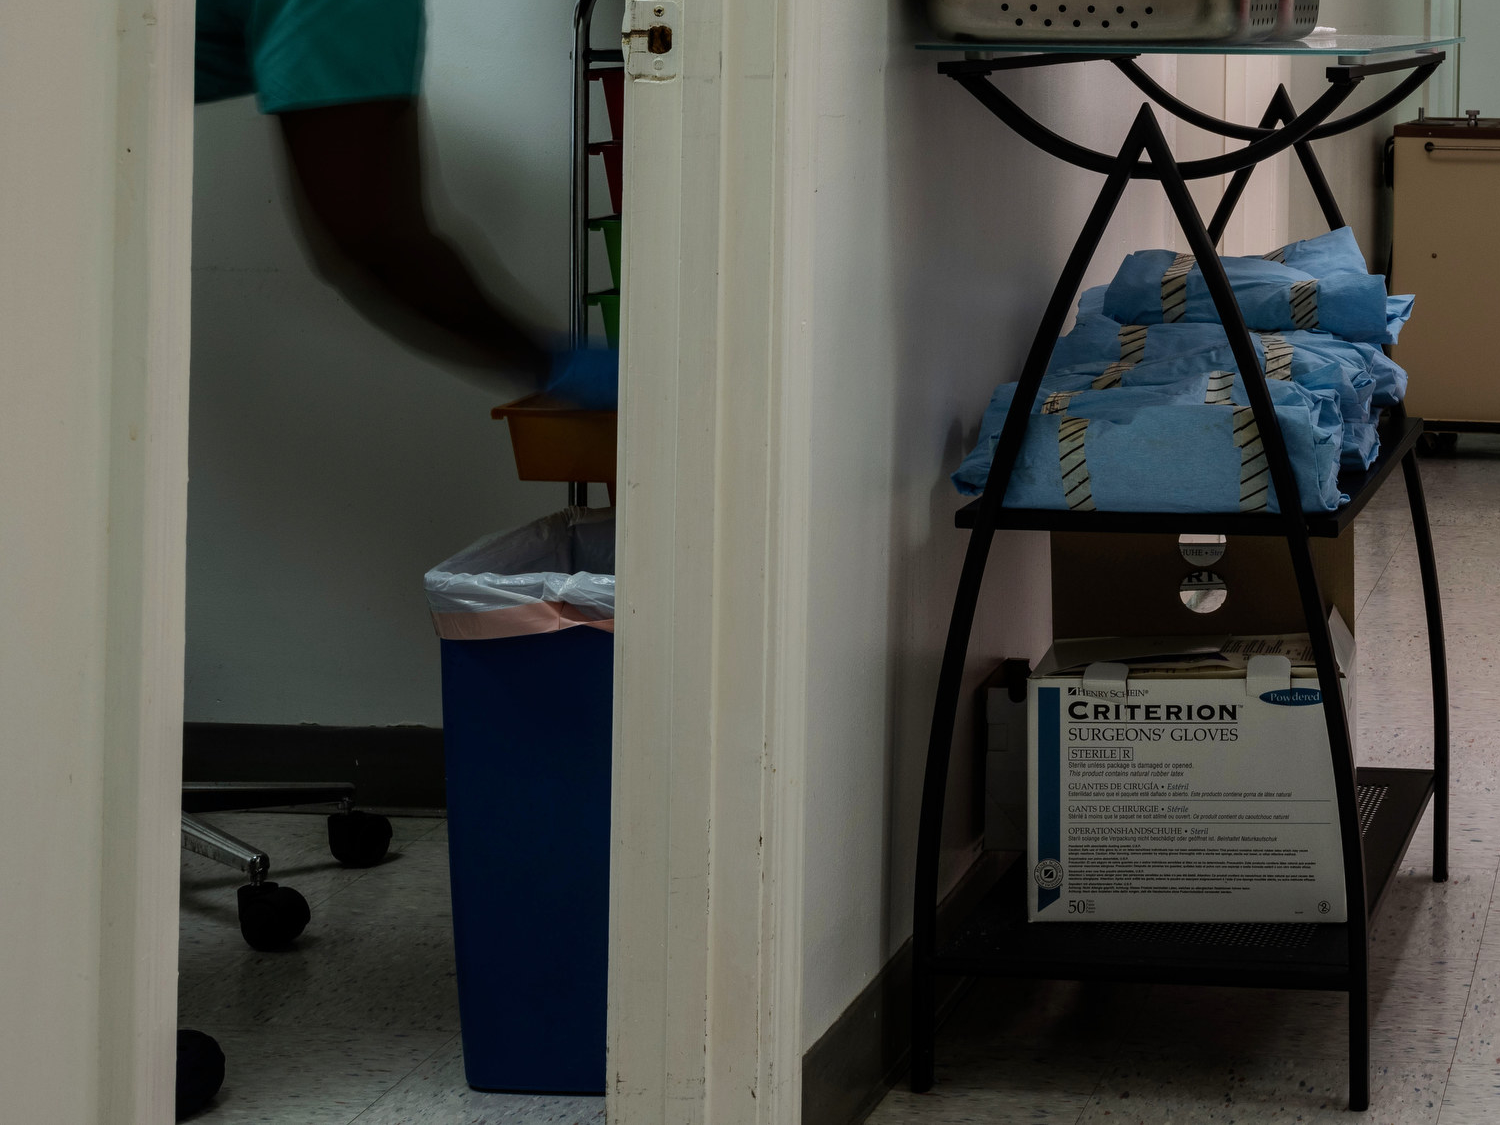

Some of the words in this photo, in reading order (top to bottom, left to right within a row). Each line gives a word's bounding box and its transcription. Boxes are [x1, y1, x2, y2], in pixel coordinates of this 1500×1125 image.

[1077, 687, 1108, 697] HENRY
[1270, 692, 1320, 701] Powdered
[1170, 728, 1238, 741] GLOVES
[1071, 749, 1116, 759] STERILE
[1123, 750, 1130, 758] R
[1069, 762, 1086, 770] Sterile
[1087, 762, 1105, 770] unless
[1107, 762, 1130, 770] package
[1132, 762, 1136, 770] is
[1138, 762, 1163, 770] damaged
[1164, 762, 1171, 770] or
[1068, 782, 1108, 790] GUANTES
[1110, 782, 1121, 790] DE
[1123, 782, 1159, 790] CIRUGÍA
[1068, 827, 1182, 835] OPERATIONSHANDSCHUHE
[1191, 827, 1208, 835] Steril
[1068, 899, 1086, 914] 50
